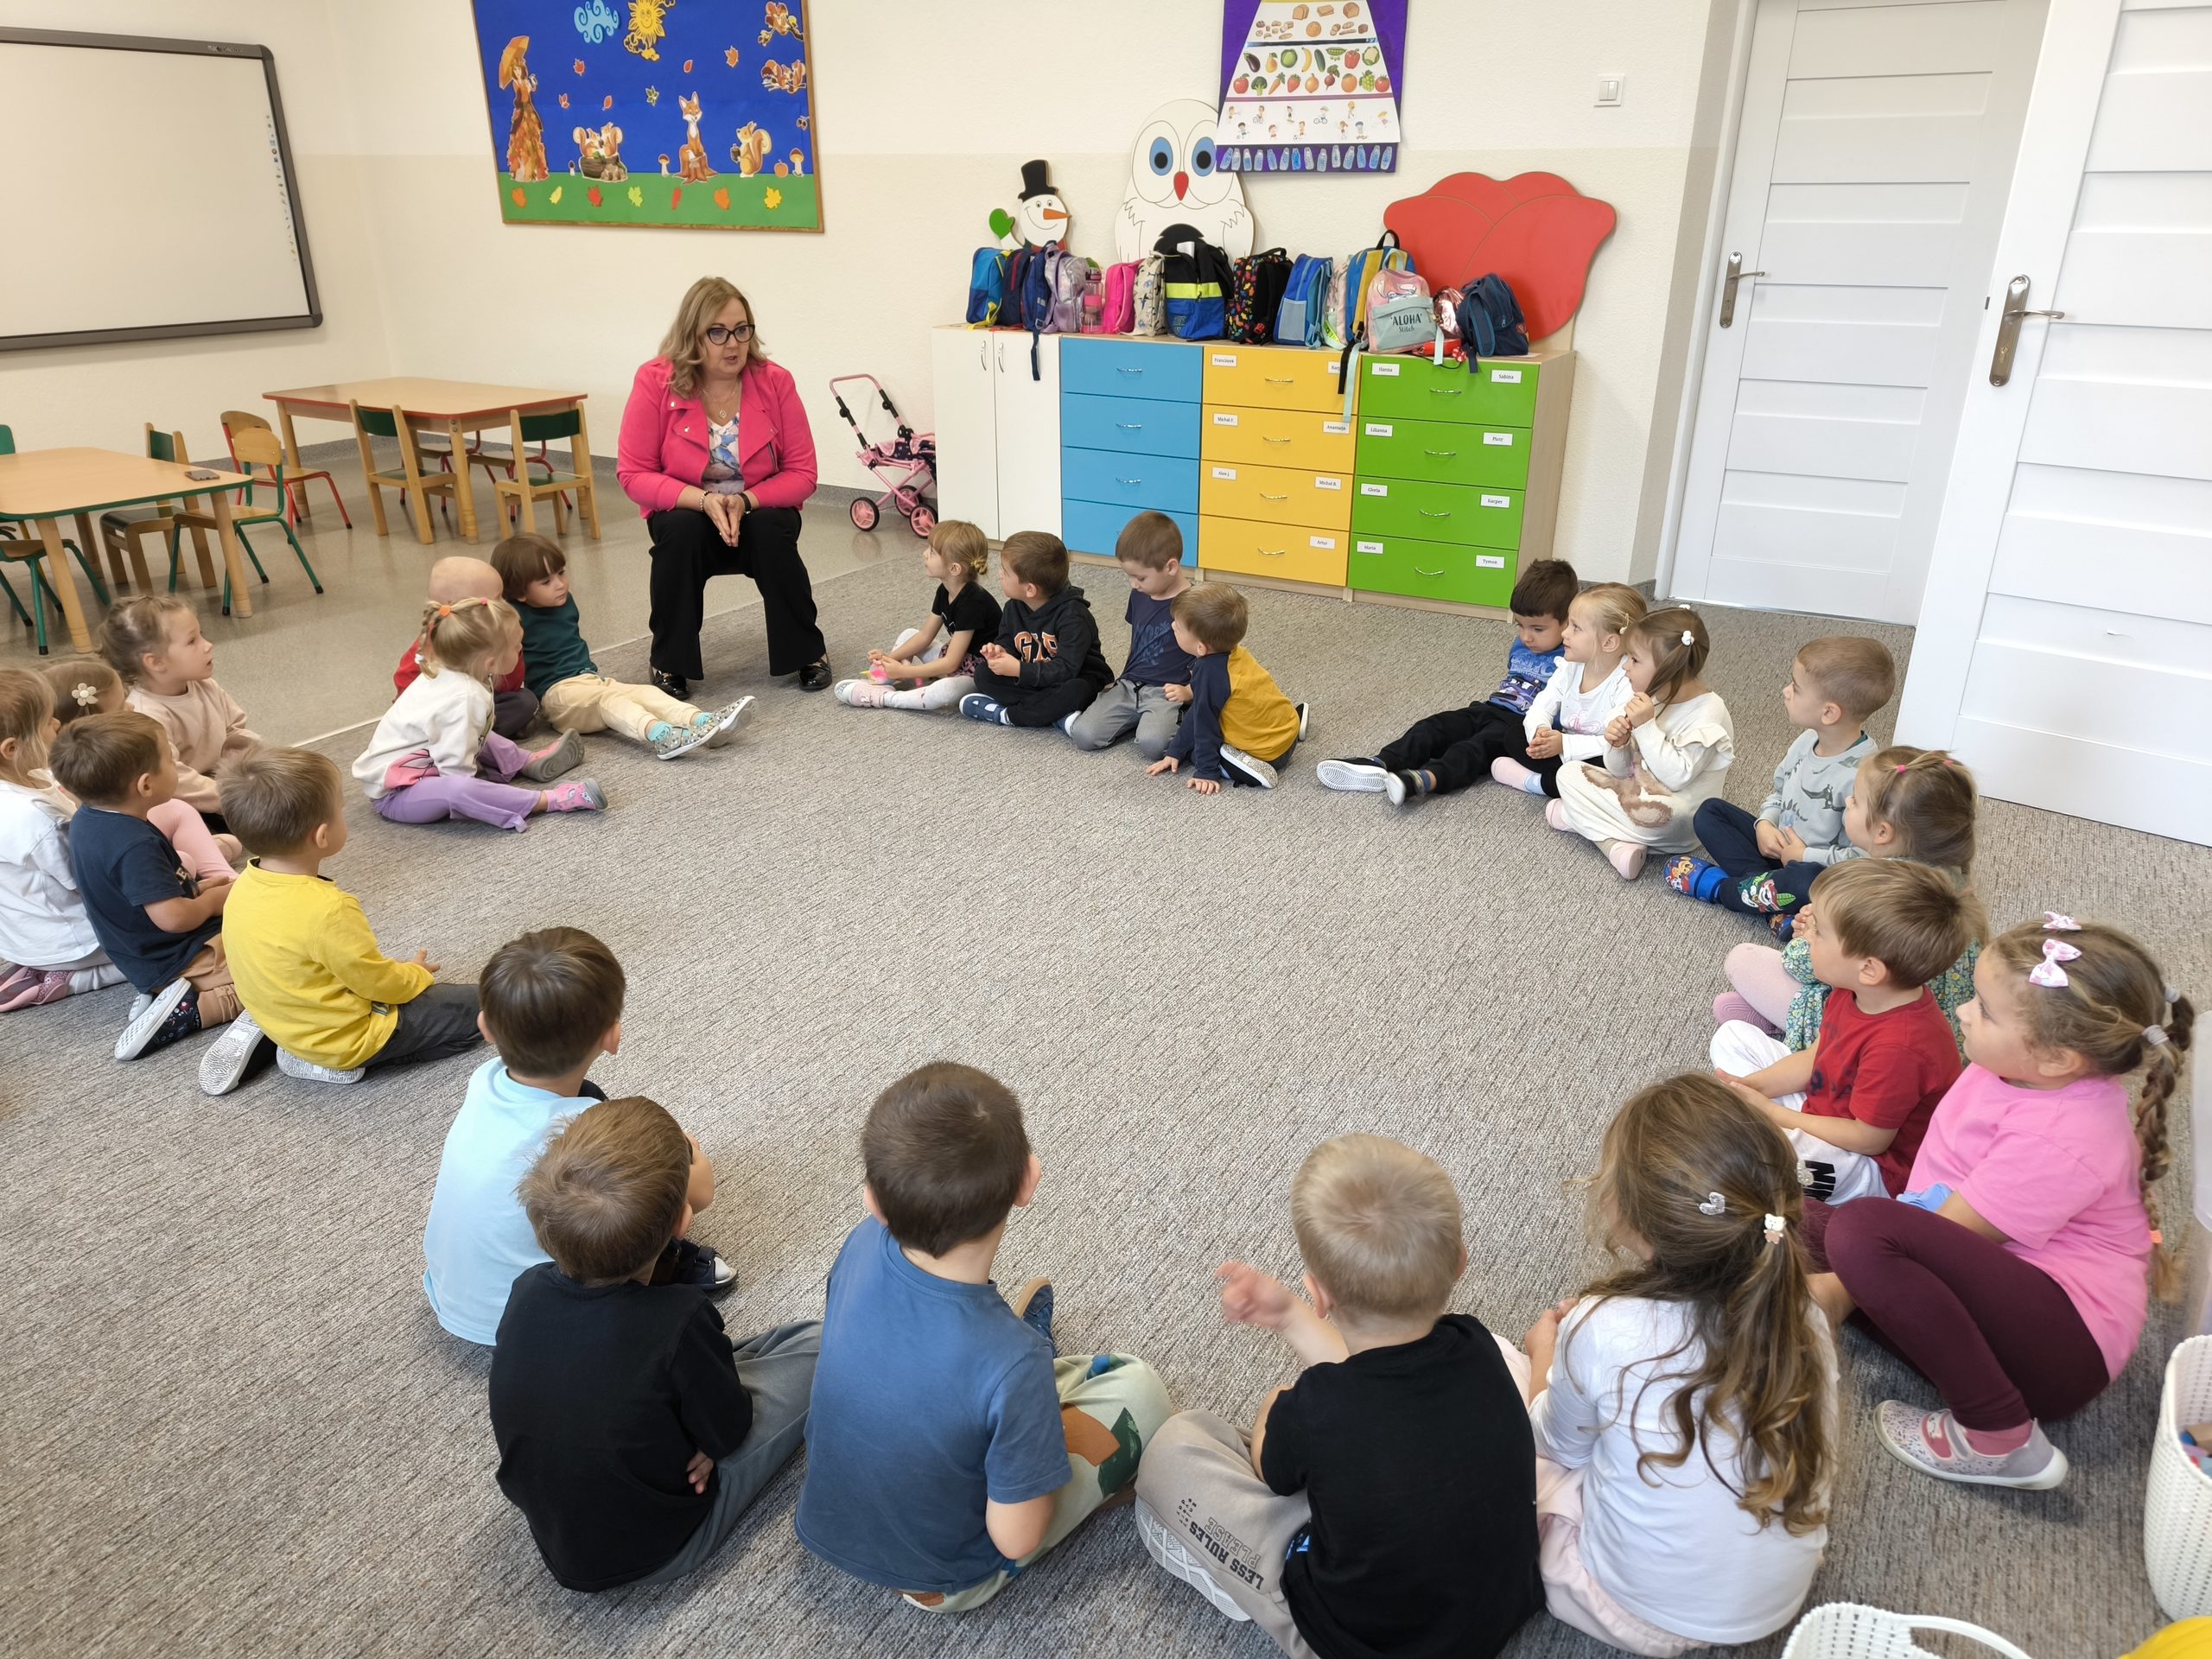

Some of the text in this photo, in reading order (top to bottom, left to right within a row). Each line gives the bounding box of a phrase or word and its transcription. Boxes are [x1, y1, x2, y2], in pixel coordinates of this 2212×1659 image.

[1392, 313, 1422, 326] ALOHA
[1189, 1521, 1264, 1591] LESS RULES
[1204, 1516, 1262, 1570] PLEASE
